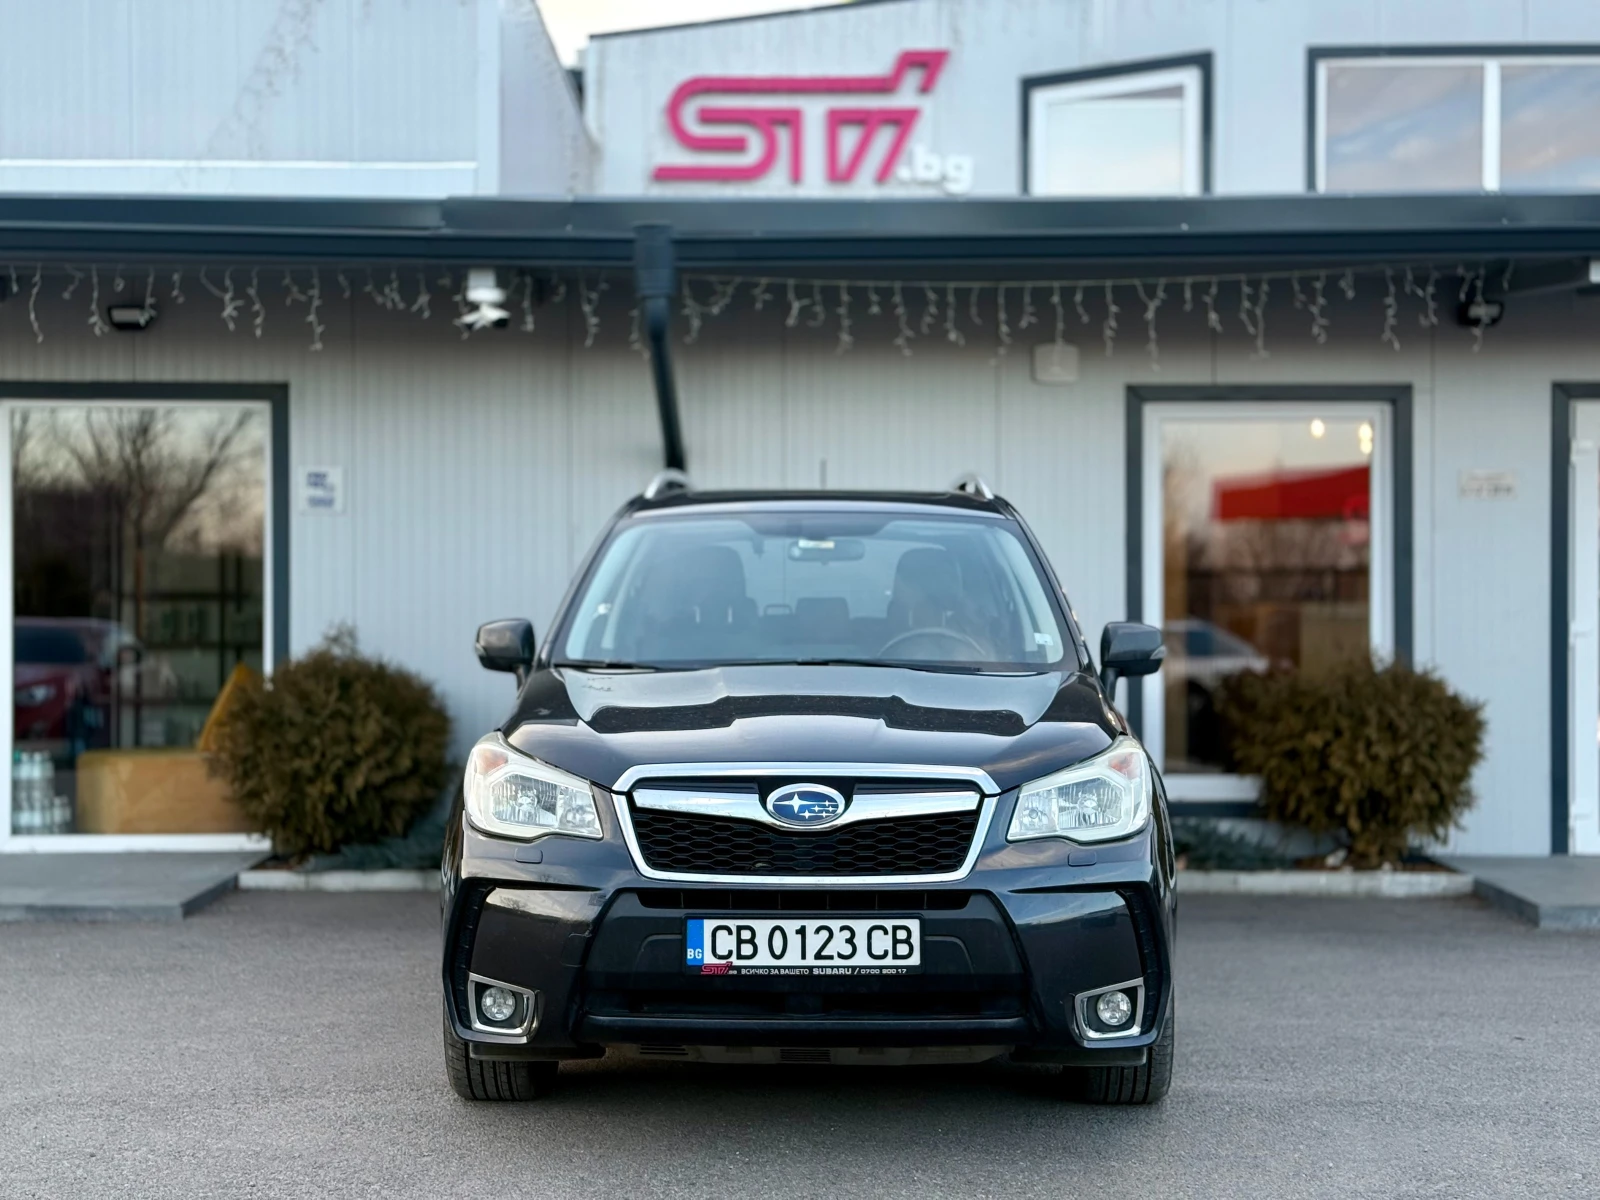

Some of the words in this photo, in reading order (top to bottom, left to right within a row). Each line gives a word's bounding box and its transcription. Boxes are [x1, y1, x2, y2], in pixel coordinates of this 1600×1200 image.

[711, 925, 759, 960] CB
[767, 925, 858, 960] 0123
[866, 925, 914, 960] CB
[687, 948, 703, 959] BG
[812, 967, 852, 975] SUBARU
